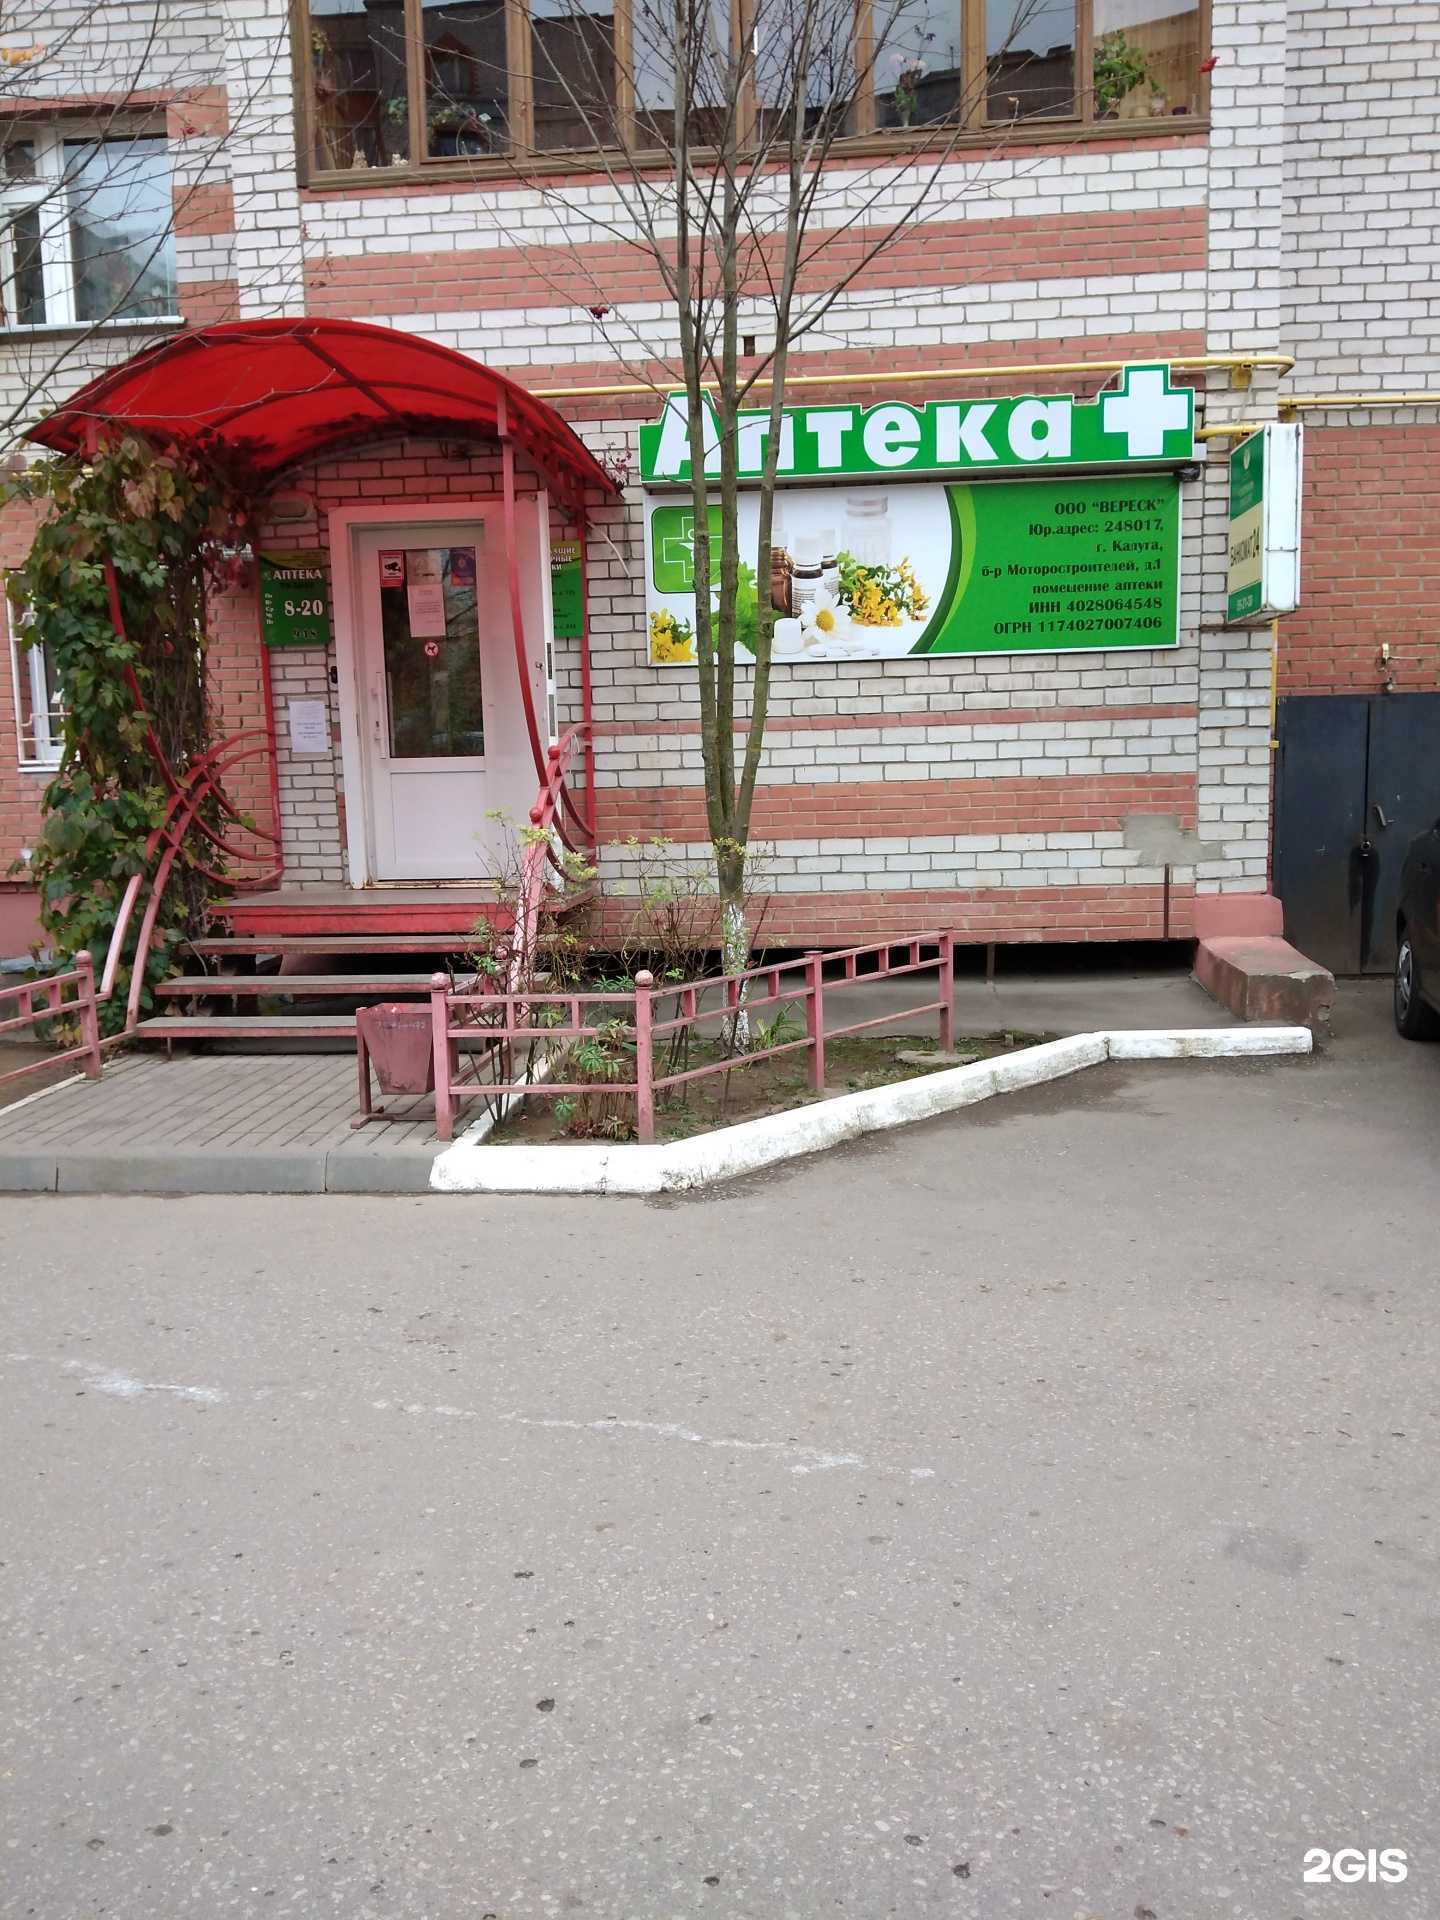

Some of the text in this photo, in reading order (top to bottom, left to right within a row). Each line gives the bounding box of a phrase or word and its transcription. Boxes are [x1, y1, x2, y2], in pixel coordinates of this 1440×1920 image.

[653, 395, 1072, 476] Аптека
[1055, 502, 1086, 515] ООО
[1029, 519, 1164, 537] Юр.адрес: 248017,
[1112, 539, 1163, 553] Калуга,
[273, 569, 322, 580] АПТЕКА
[1115, 579, 1163, 591] аптеки
[284, 599, 324, 617] 8-20
[1029, 597, 1162, 614] ИНН 4028064548
[993, 617, 1162, 635] ОГРН 1174027007406
